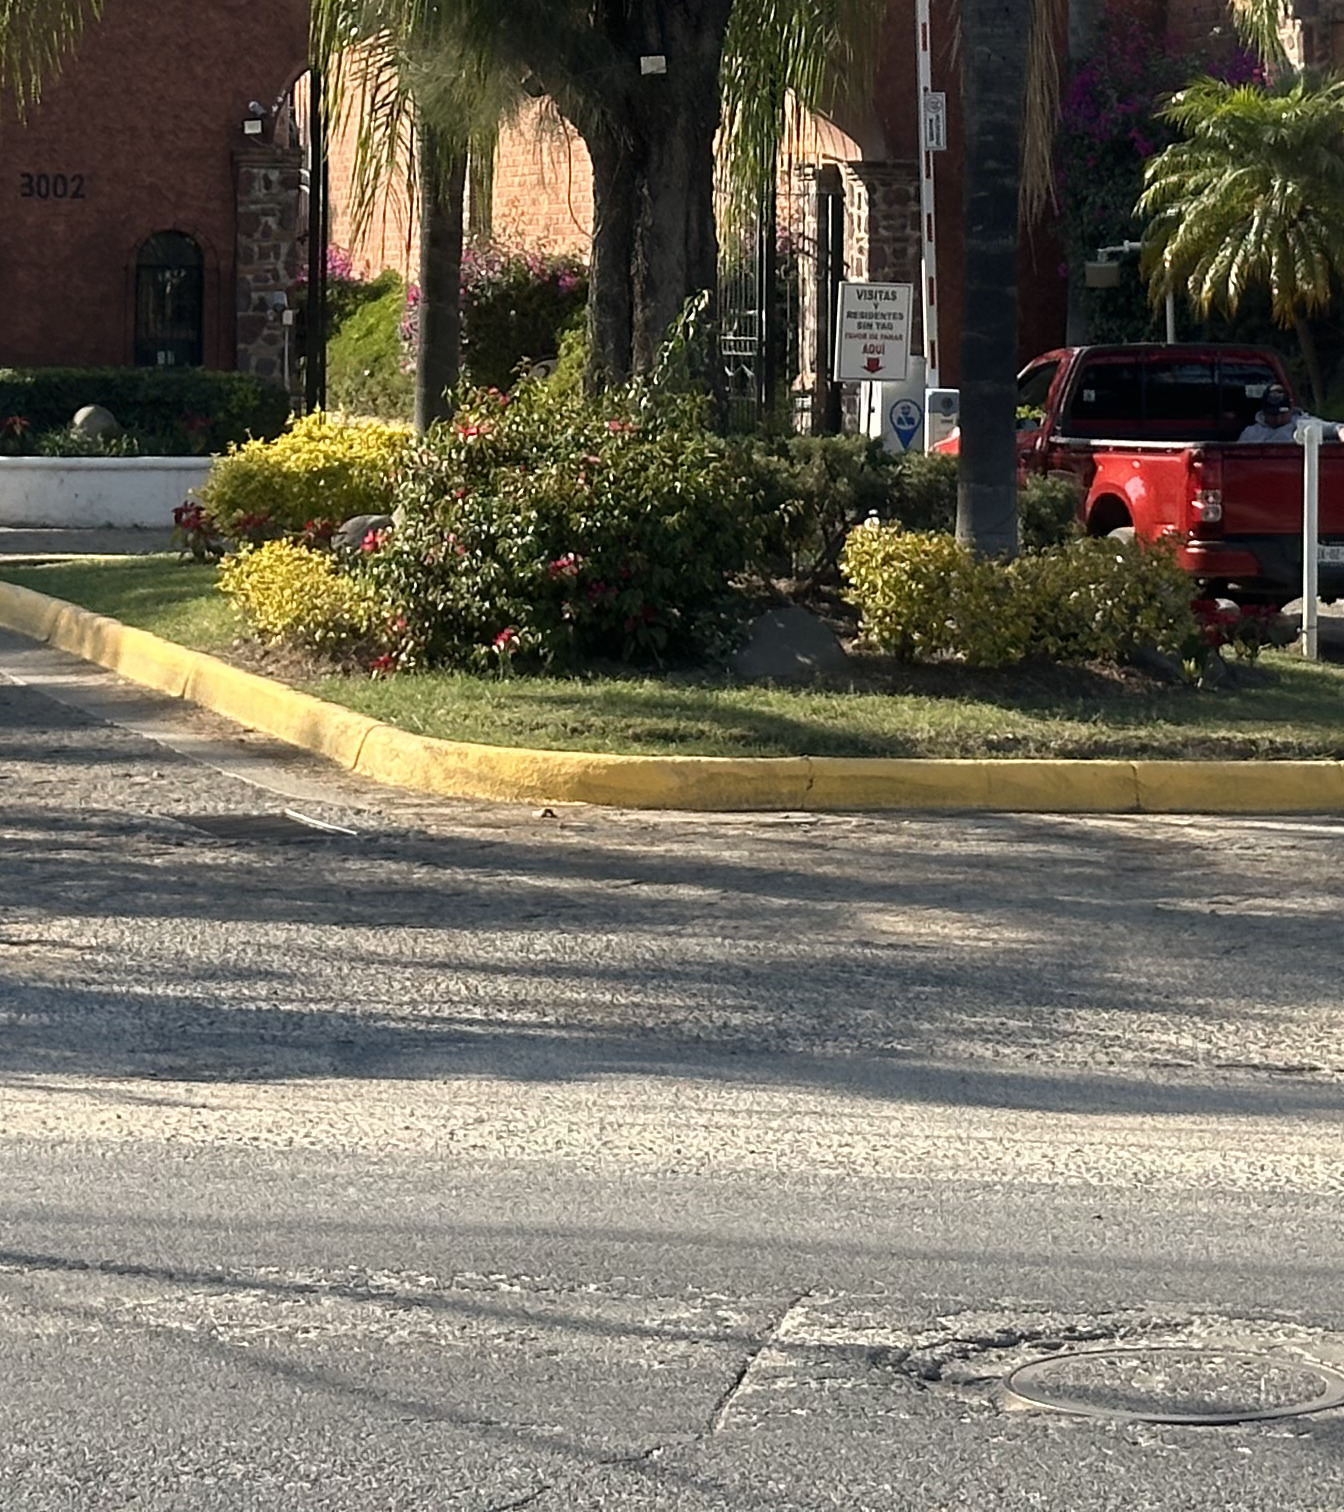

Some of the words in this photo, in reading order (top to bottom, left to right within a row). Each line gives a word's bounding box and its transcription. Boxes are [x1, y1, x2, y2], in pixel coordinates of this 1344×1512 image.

[20, 172, 86, 199] 3002
[856, 289, 897, 301] VISITAS
[873, 302, 879, 310] Y
[846, 311, 904, 321] RESIDENTES
[857, 321, 873, 330] SIN
